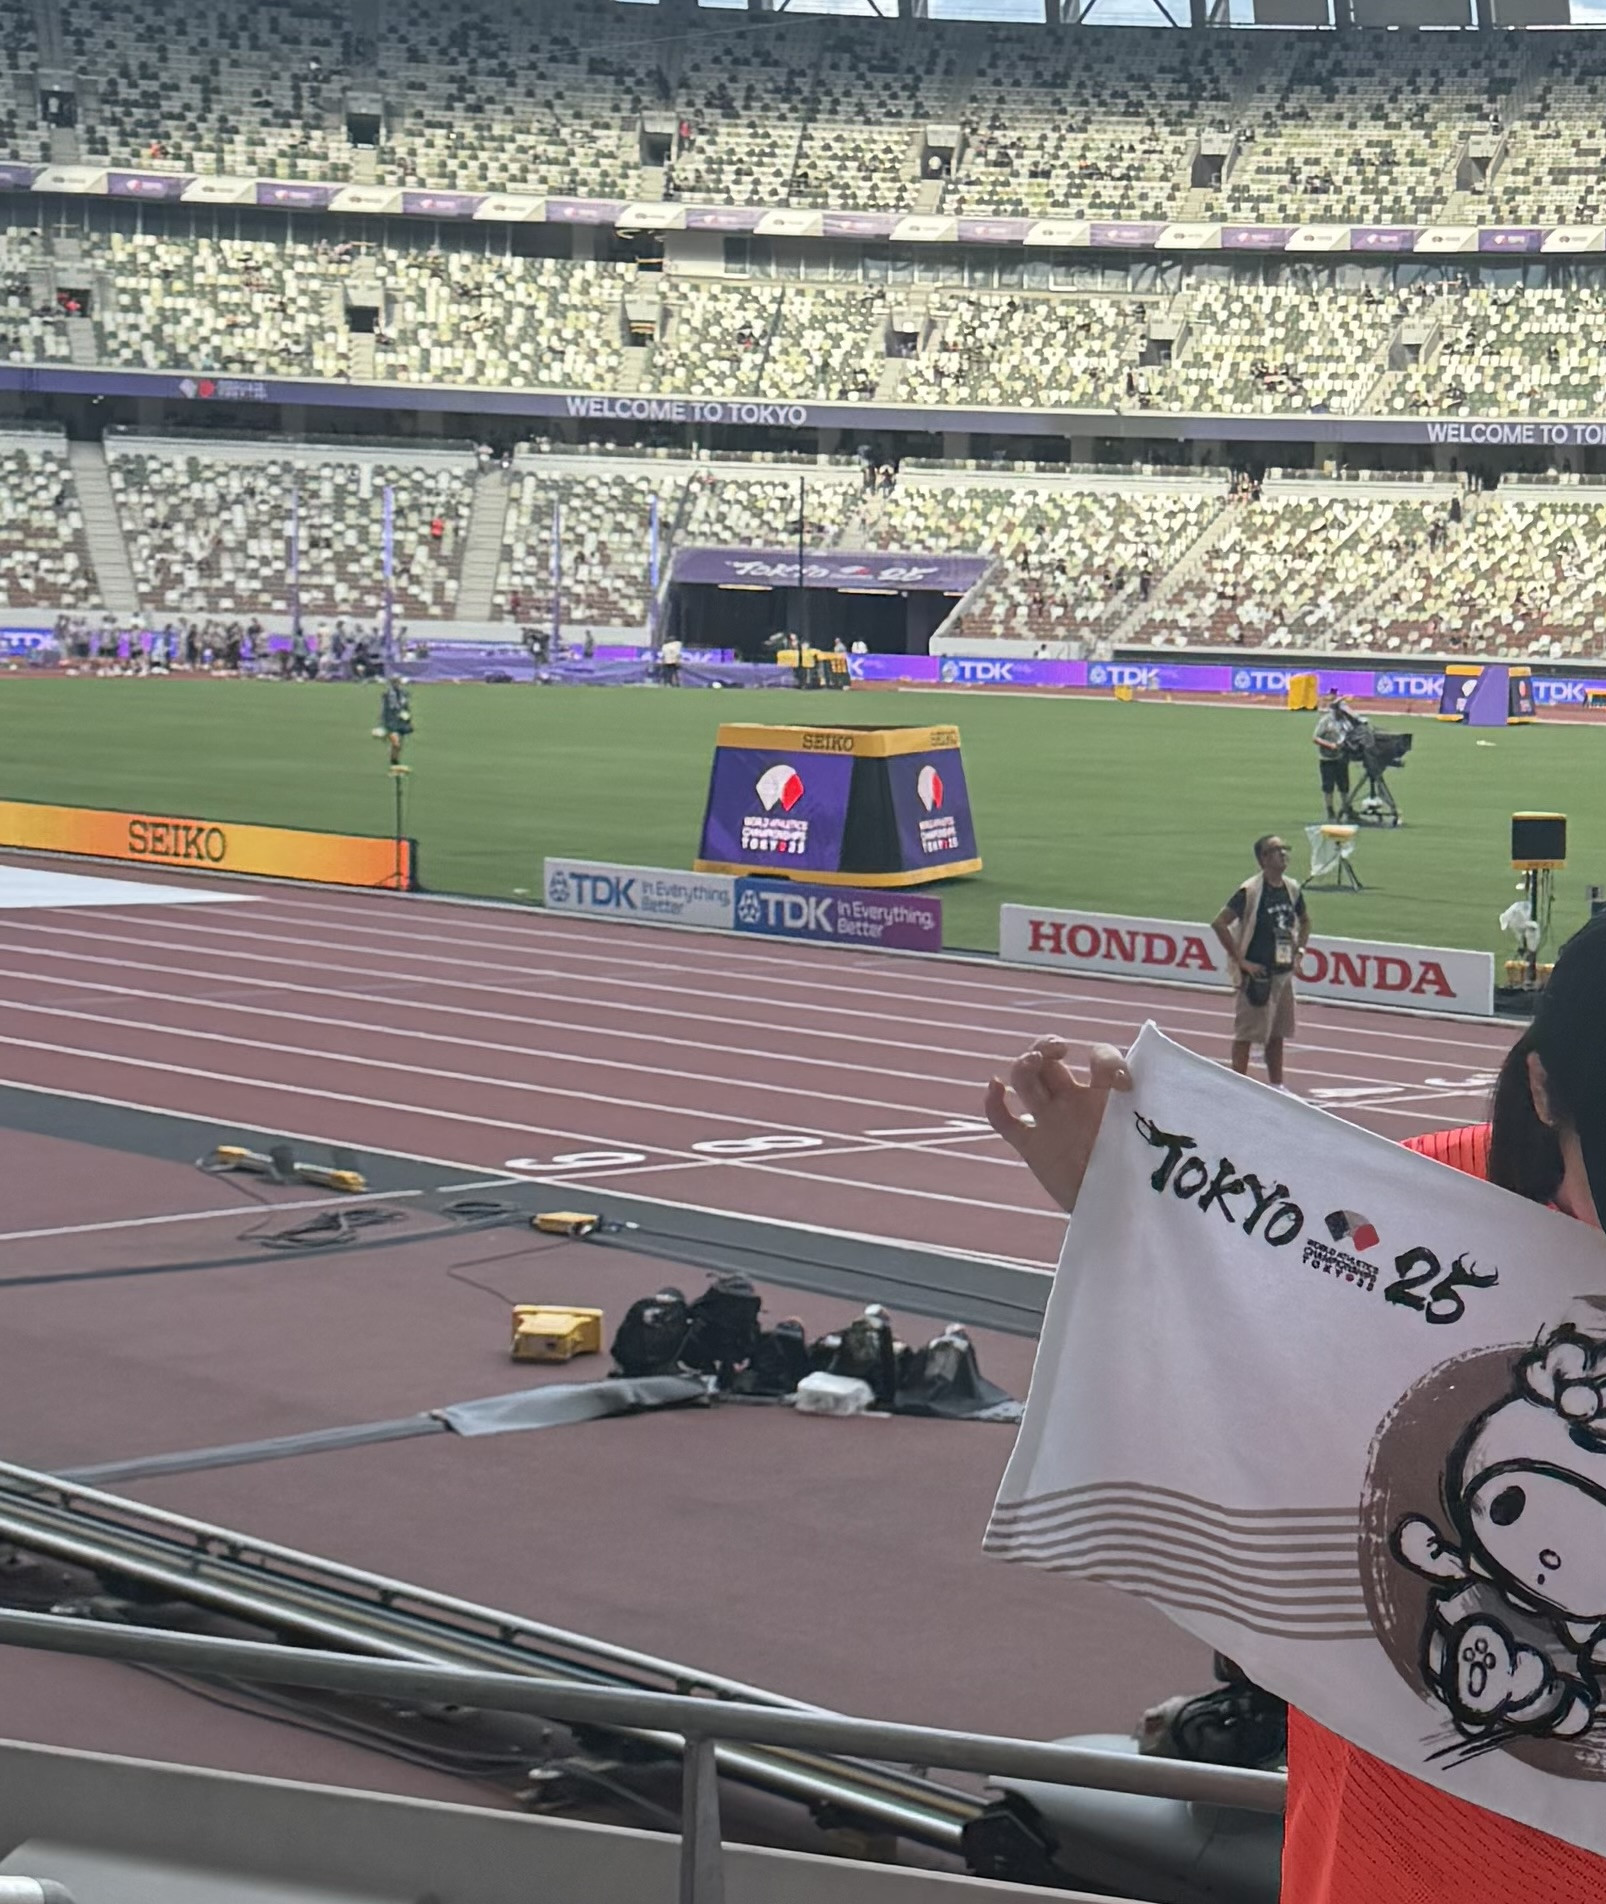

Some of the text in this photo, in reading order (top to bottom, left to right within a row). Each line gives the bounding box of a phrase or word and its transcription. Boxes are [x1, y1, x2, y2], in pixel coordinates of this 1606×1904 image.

[566, 396, 807, 425] WELCOME TO TOKYO
[1427, 423, 1534, 444] WELCOME
[1540, 424, 1568, 444] TO
[959, 661, 1014, 680] TDK
[1107, 666, 1160, 686] TDK
[1250, 671, 1291, 690] TD
[1394, 676, 1444, 695] TDK
[1532, 681, 1586, 700] TDK
[803, 733, 854, 752] SEIKO
[128, 819, 226, 863] SEIKO
[569, 873, 636, 911] TDK
[642, 881, 654, 896] In
[759, 892, 834, 933] TDK
[837, 899, 851, 916] In
[837, 919, 884, 938] Better
[1028, 919, 1217, 972] HONDA
[1296, 947, 1457, 998] ONDA
[1134, 1110, 1499, 1325] TOKYO 25
